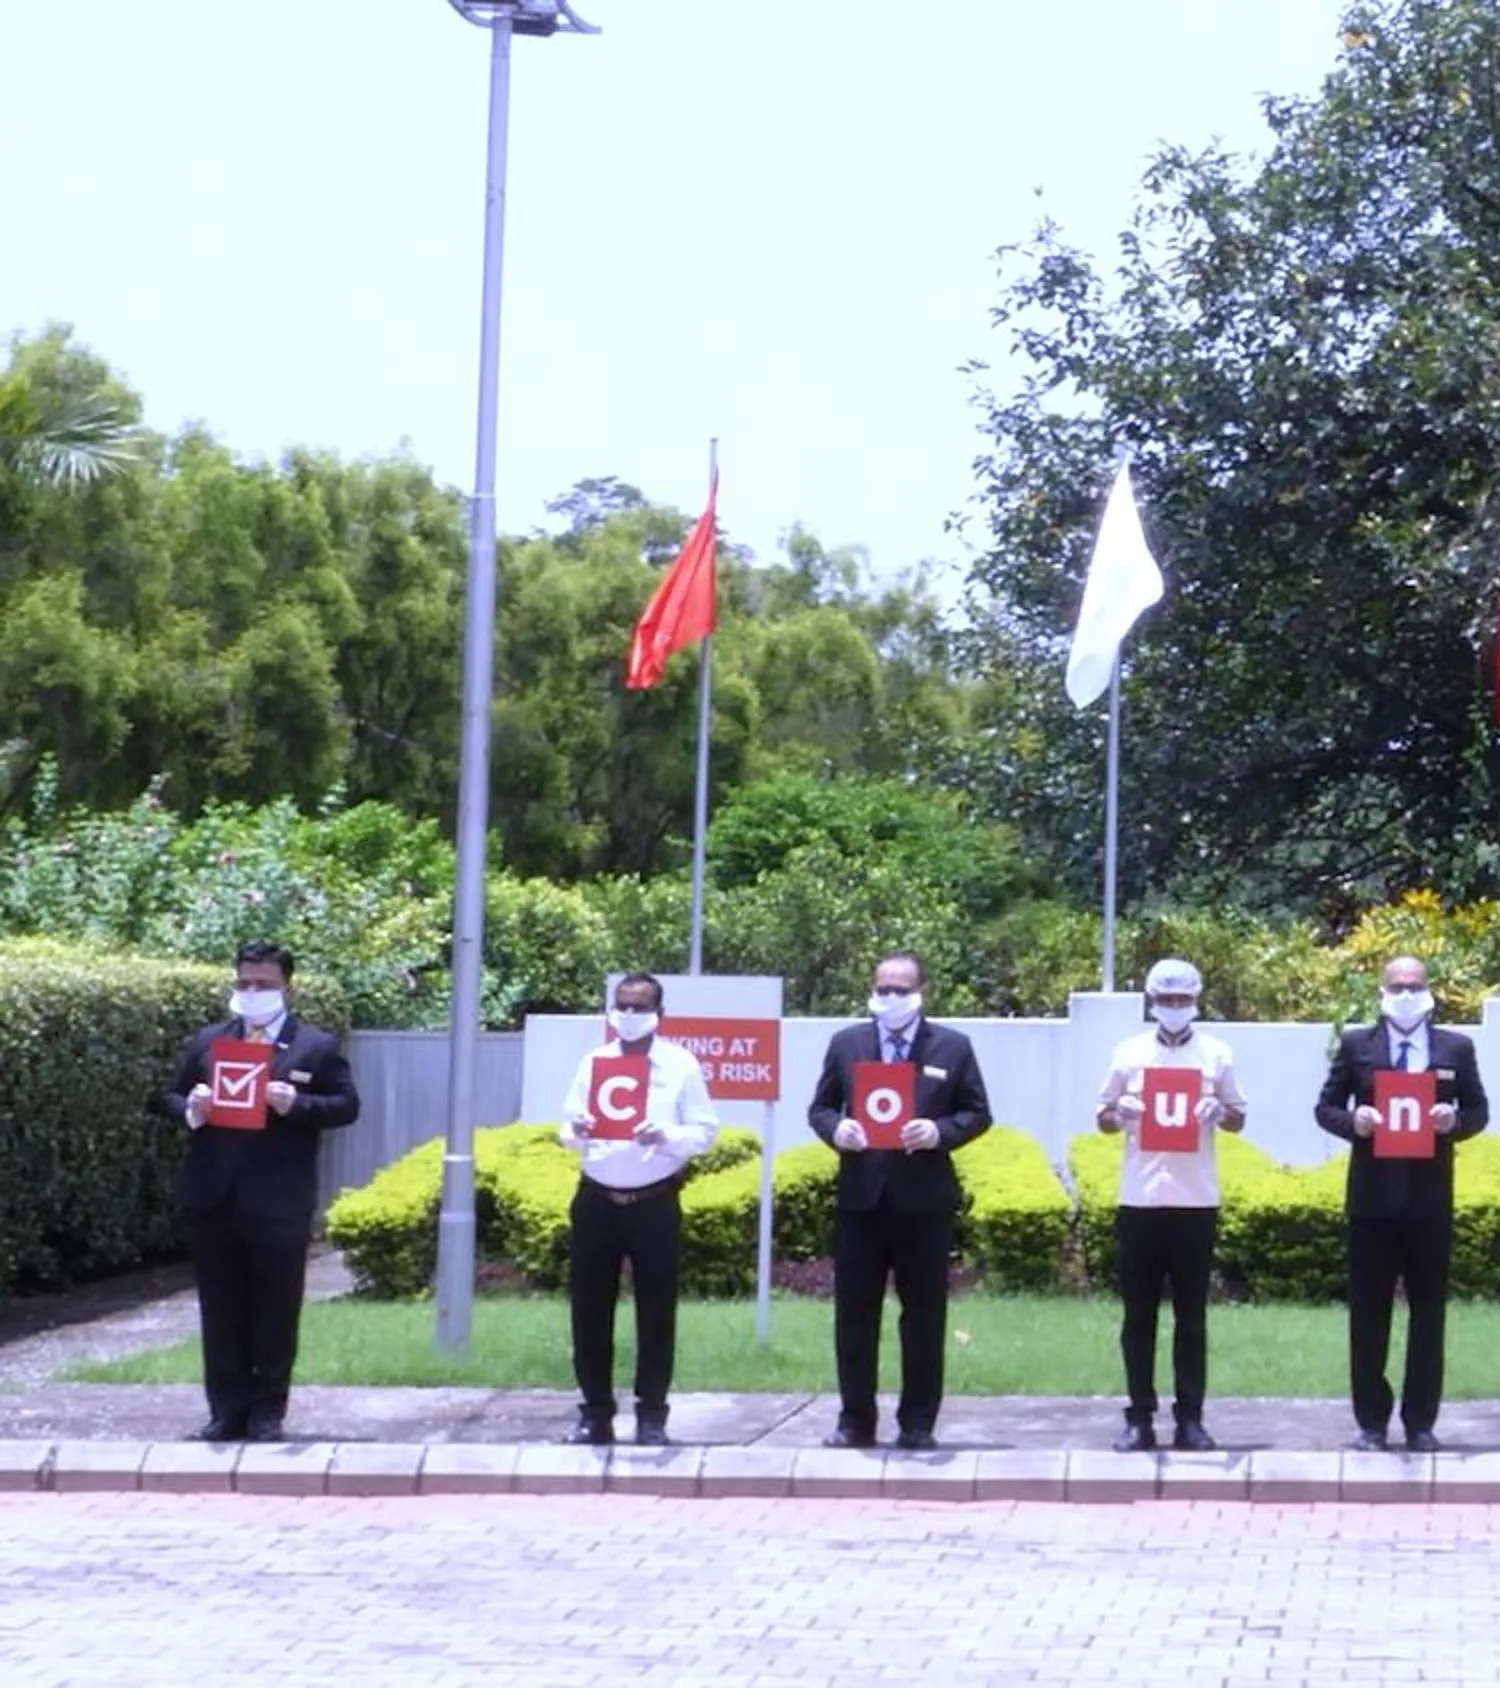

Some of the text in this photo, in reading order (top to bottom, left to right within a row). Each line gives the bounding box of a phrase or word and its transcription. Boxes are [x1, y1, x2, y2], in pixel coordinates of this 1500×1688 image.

[729, 1037, 757, 1057] AT
[720, 1062, 773, 1083] RISK
[596, 1074, 639, 1121] C
[1154, 1091, 1189, 1128] u
[1388, 1096, 1421, 1132] n
